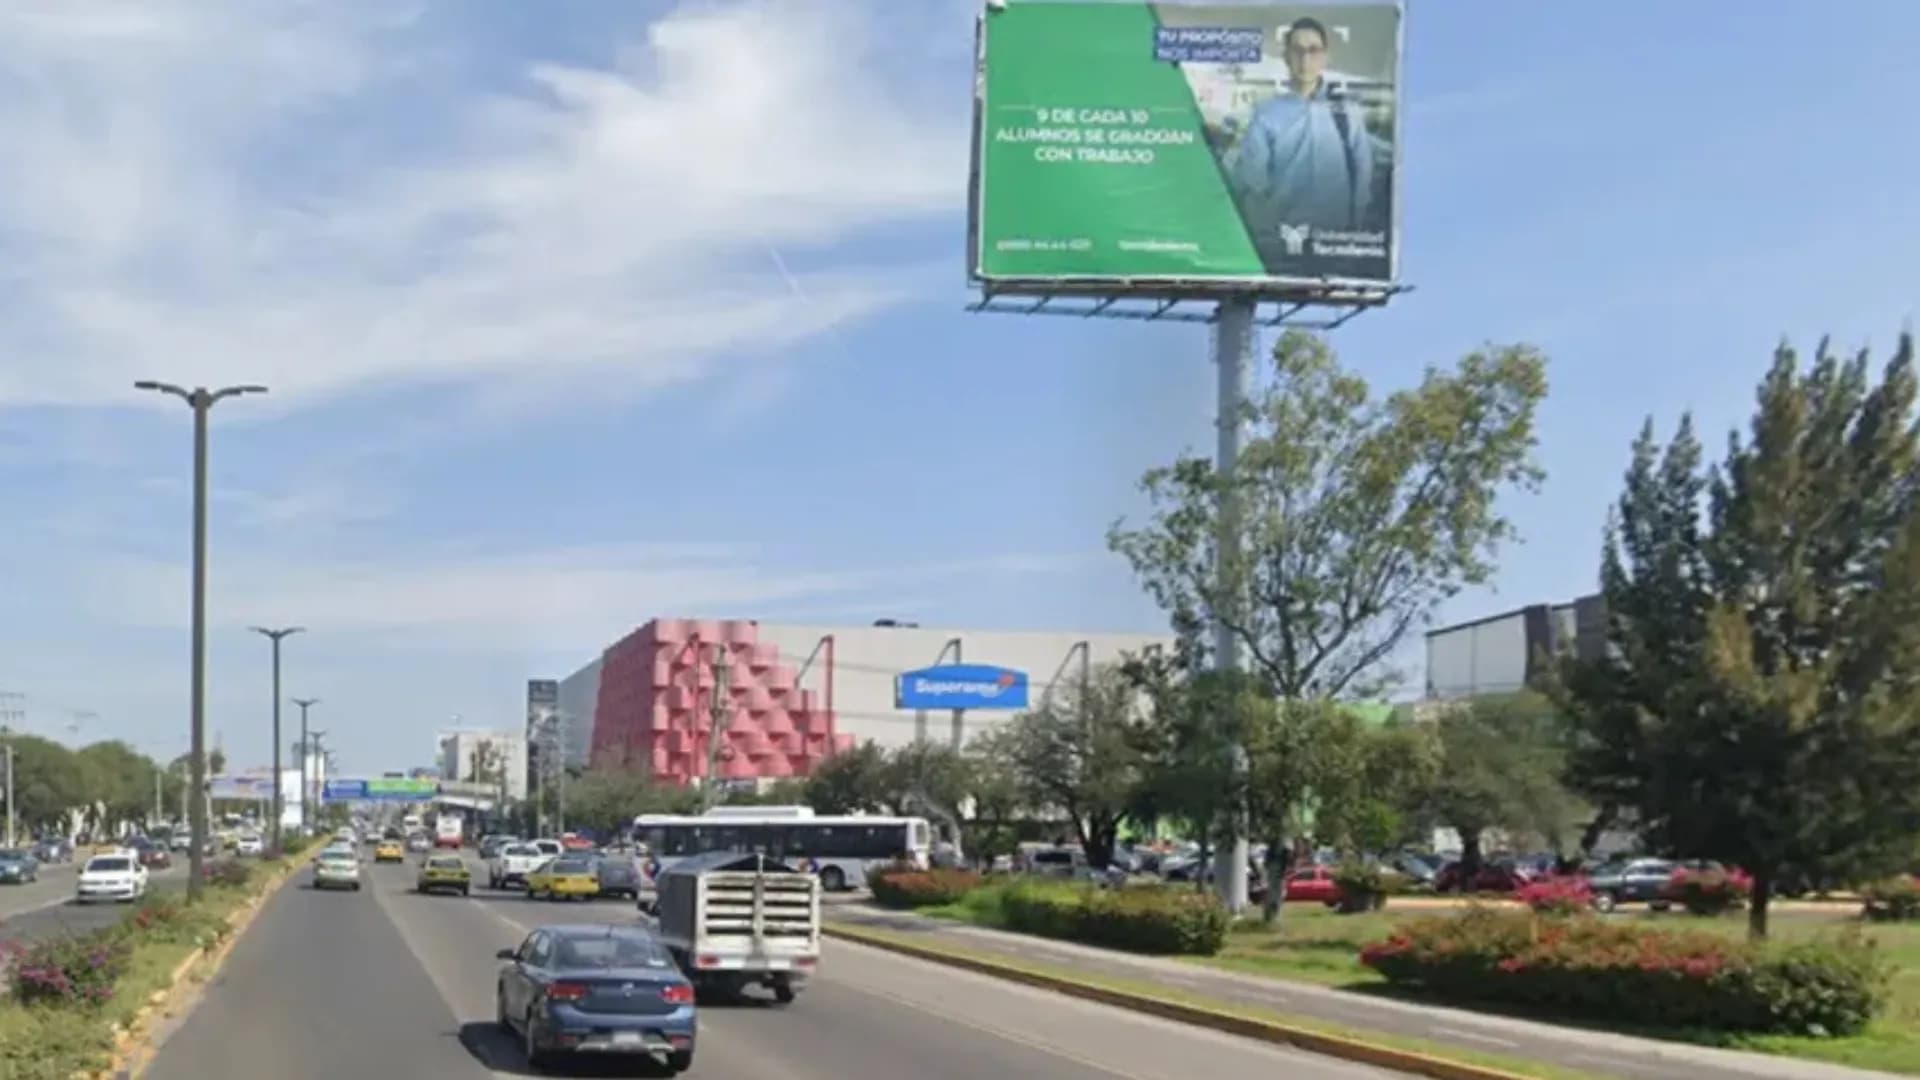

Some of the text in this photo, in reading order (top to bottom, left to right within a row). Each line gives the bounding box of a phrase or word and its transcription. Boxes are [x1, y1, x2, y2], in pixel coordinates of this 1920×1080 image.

[1159, 31, 1177, 43] TU
[1036, 108, 1149, 125] 9 DE CADA 10
[996, 128, 1080, 143] ALUMNOS
[1085, 129, 1105, 143] SE
[1034, 146, 1155, 163] CON TRABAJO
